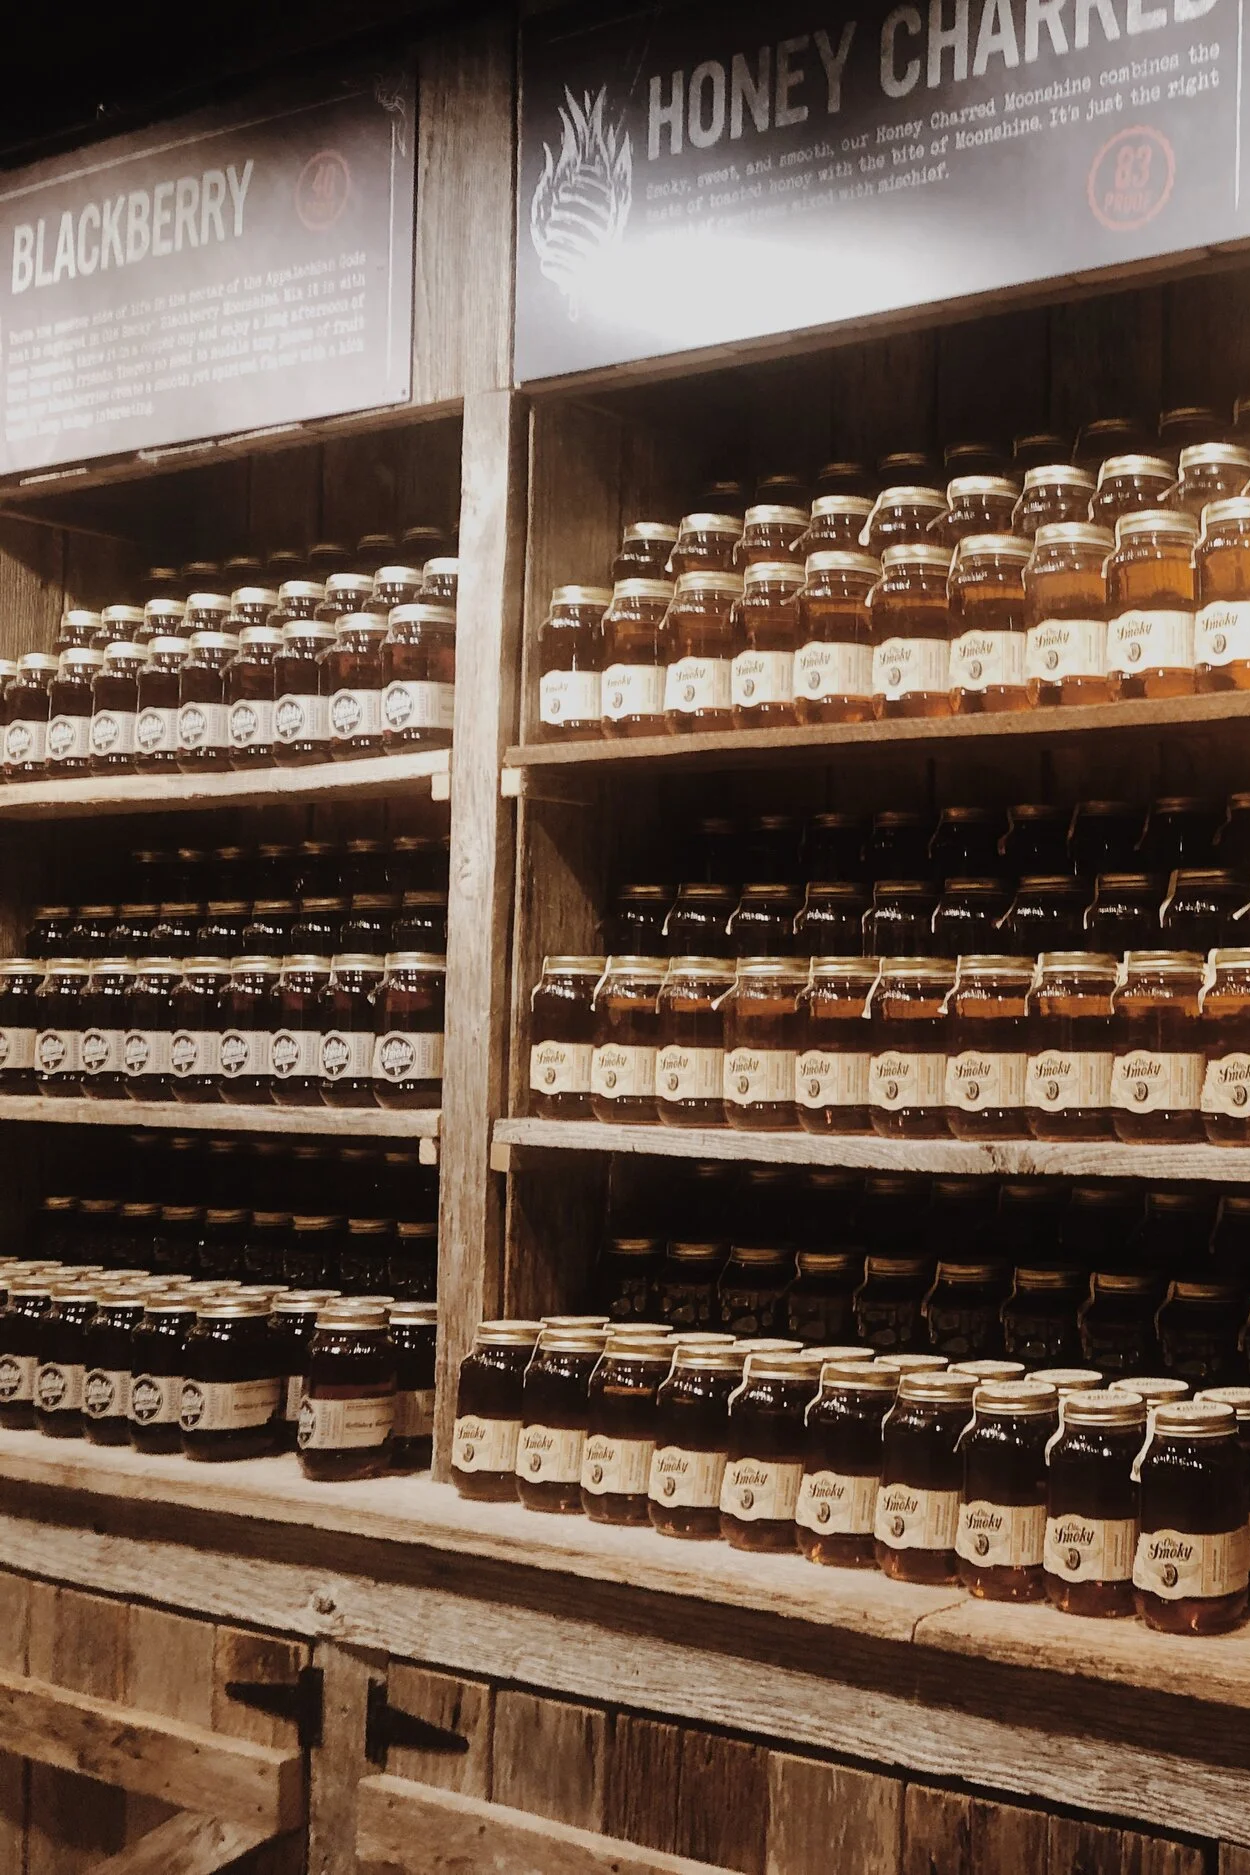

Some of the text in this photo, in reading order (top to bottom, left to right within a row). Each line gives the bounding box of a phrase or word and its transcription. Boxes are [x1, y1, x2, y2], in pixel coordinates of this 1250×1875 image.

[647, 0, 1217, 160] HONEY CHARR
[746, 155, 771, 176] and
[779, 139, 834, 169] smooth,
[841, 134, 868, 151] our
[876, 116, 922, 147] Honey
[931, 97, 995, 131] Charred
[1004, 72, 1090, 112] Moonshine
[1099, 50, 1179, 88] combines
[1188, 38, 1219, 66] the
[687, 195, 703, 214] of
[710, 181, 761, 208] toasted
[769, 170, 811, 198] honey
[818, 159, 852, 183] with
[859, 151, 884, 173] the
[891, 140, 924, 165] bite
[930, 134, 948, 156] of
[955, 111, 1041, 150] Moonshine.
[1049, 100, 1079, 128] It's
[1086, 90, 1122, 121] just
[1130, 80, 1160, 107] the
[1168, 66, 1219, 101] right
[839, 179, 872, 201] with
[877, 160, 949, 193] mischief.
[1115, 144, 1152, 188] 83
[12, 159, 254, 294] BLACKBERRY
[1104, 190, 1153, 213] PROOF
[226, 277, 239, 294] of
[243, 274, 261, 291] the
